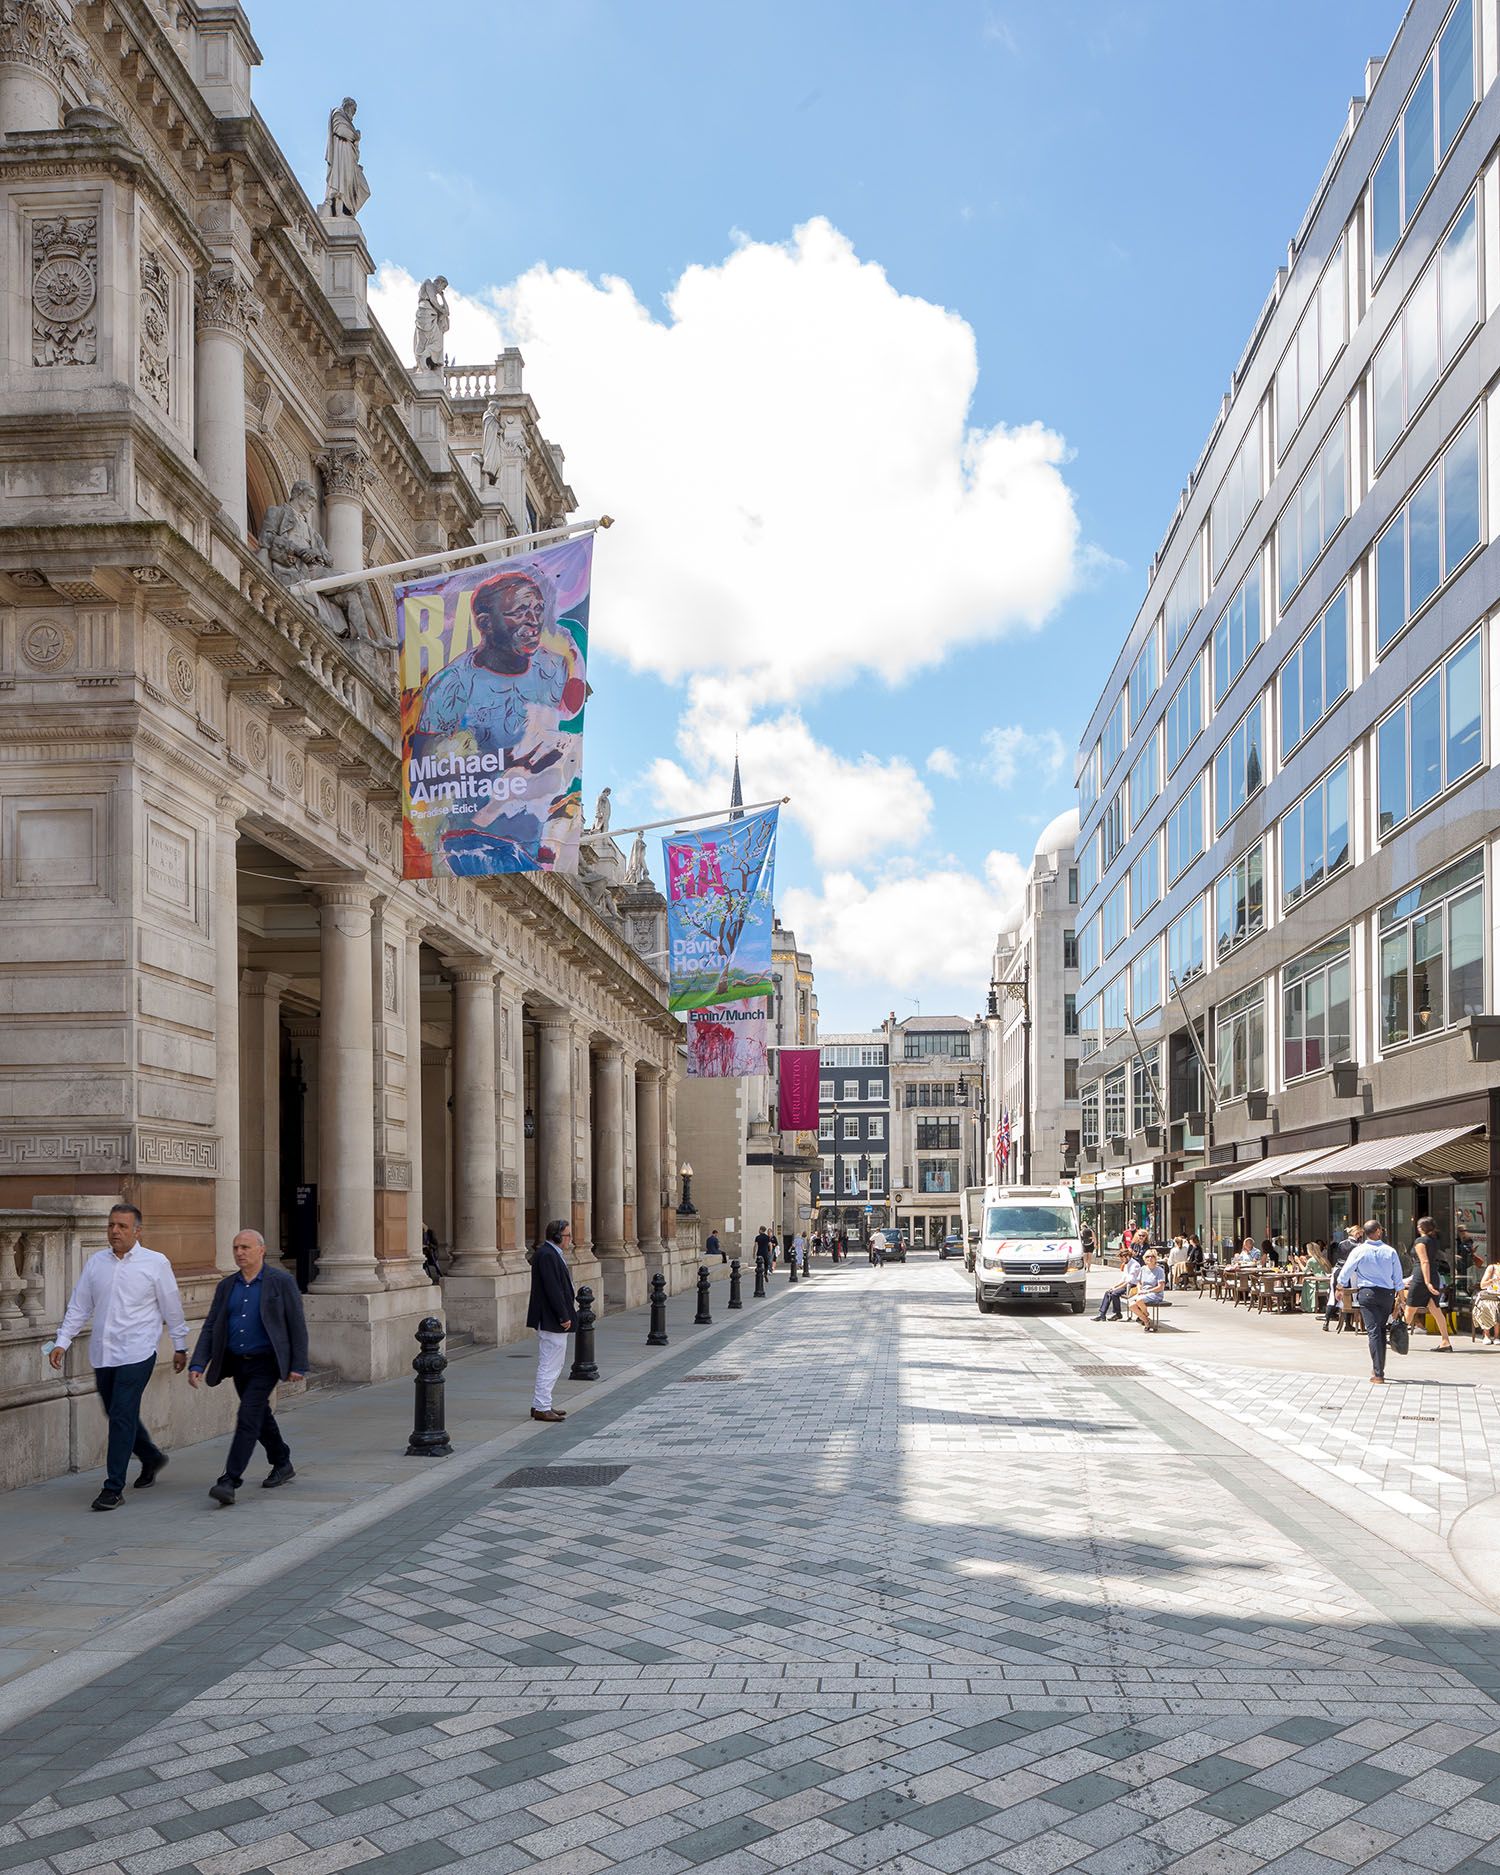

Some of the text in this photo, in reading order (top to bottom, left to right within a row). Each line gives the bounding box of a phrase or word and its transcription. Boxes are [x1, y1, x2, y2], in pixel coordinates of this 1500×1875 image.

[410, 748, 505, 782] Michael
[411, 775, 527, 805] Armitage
[410, 803, 478, 819] Paradise Edict
[668, 842, 725, 901] RA
[673, 936, 720, 955] David
[690, 1009, 765, 1022] Emin/Munch
[792, 1057, 801, 1124] BURLINGTON
